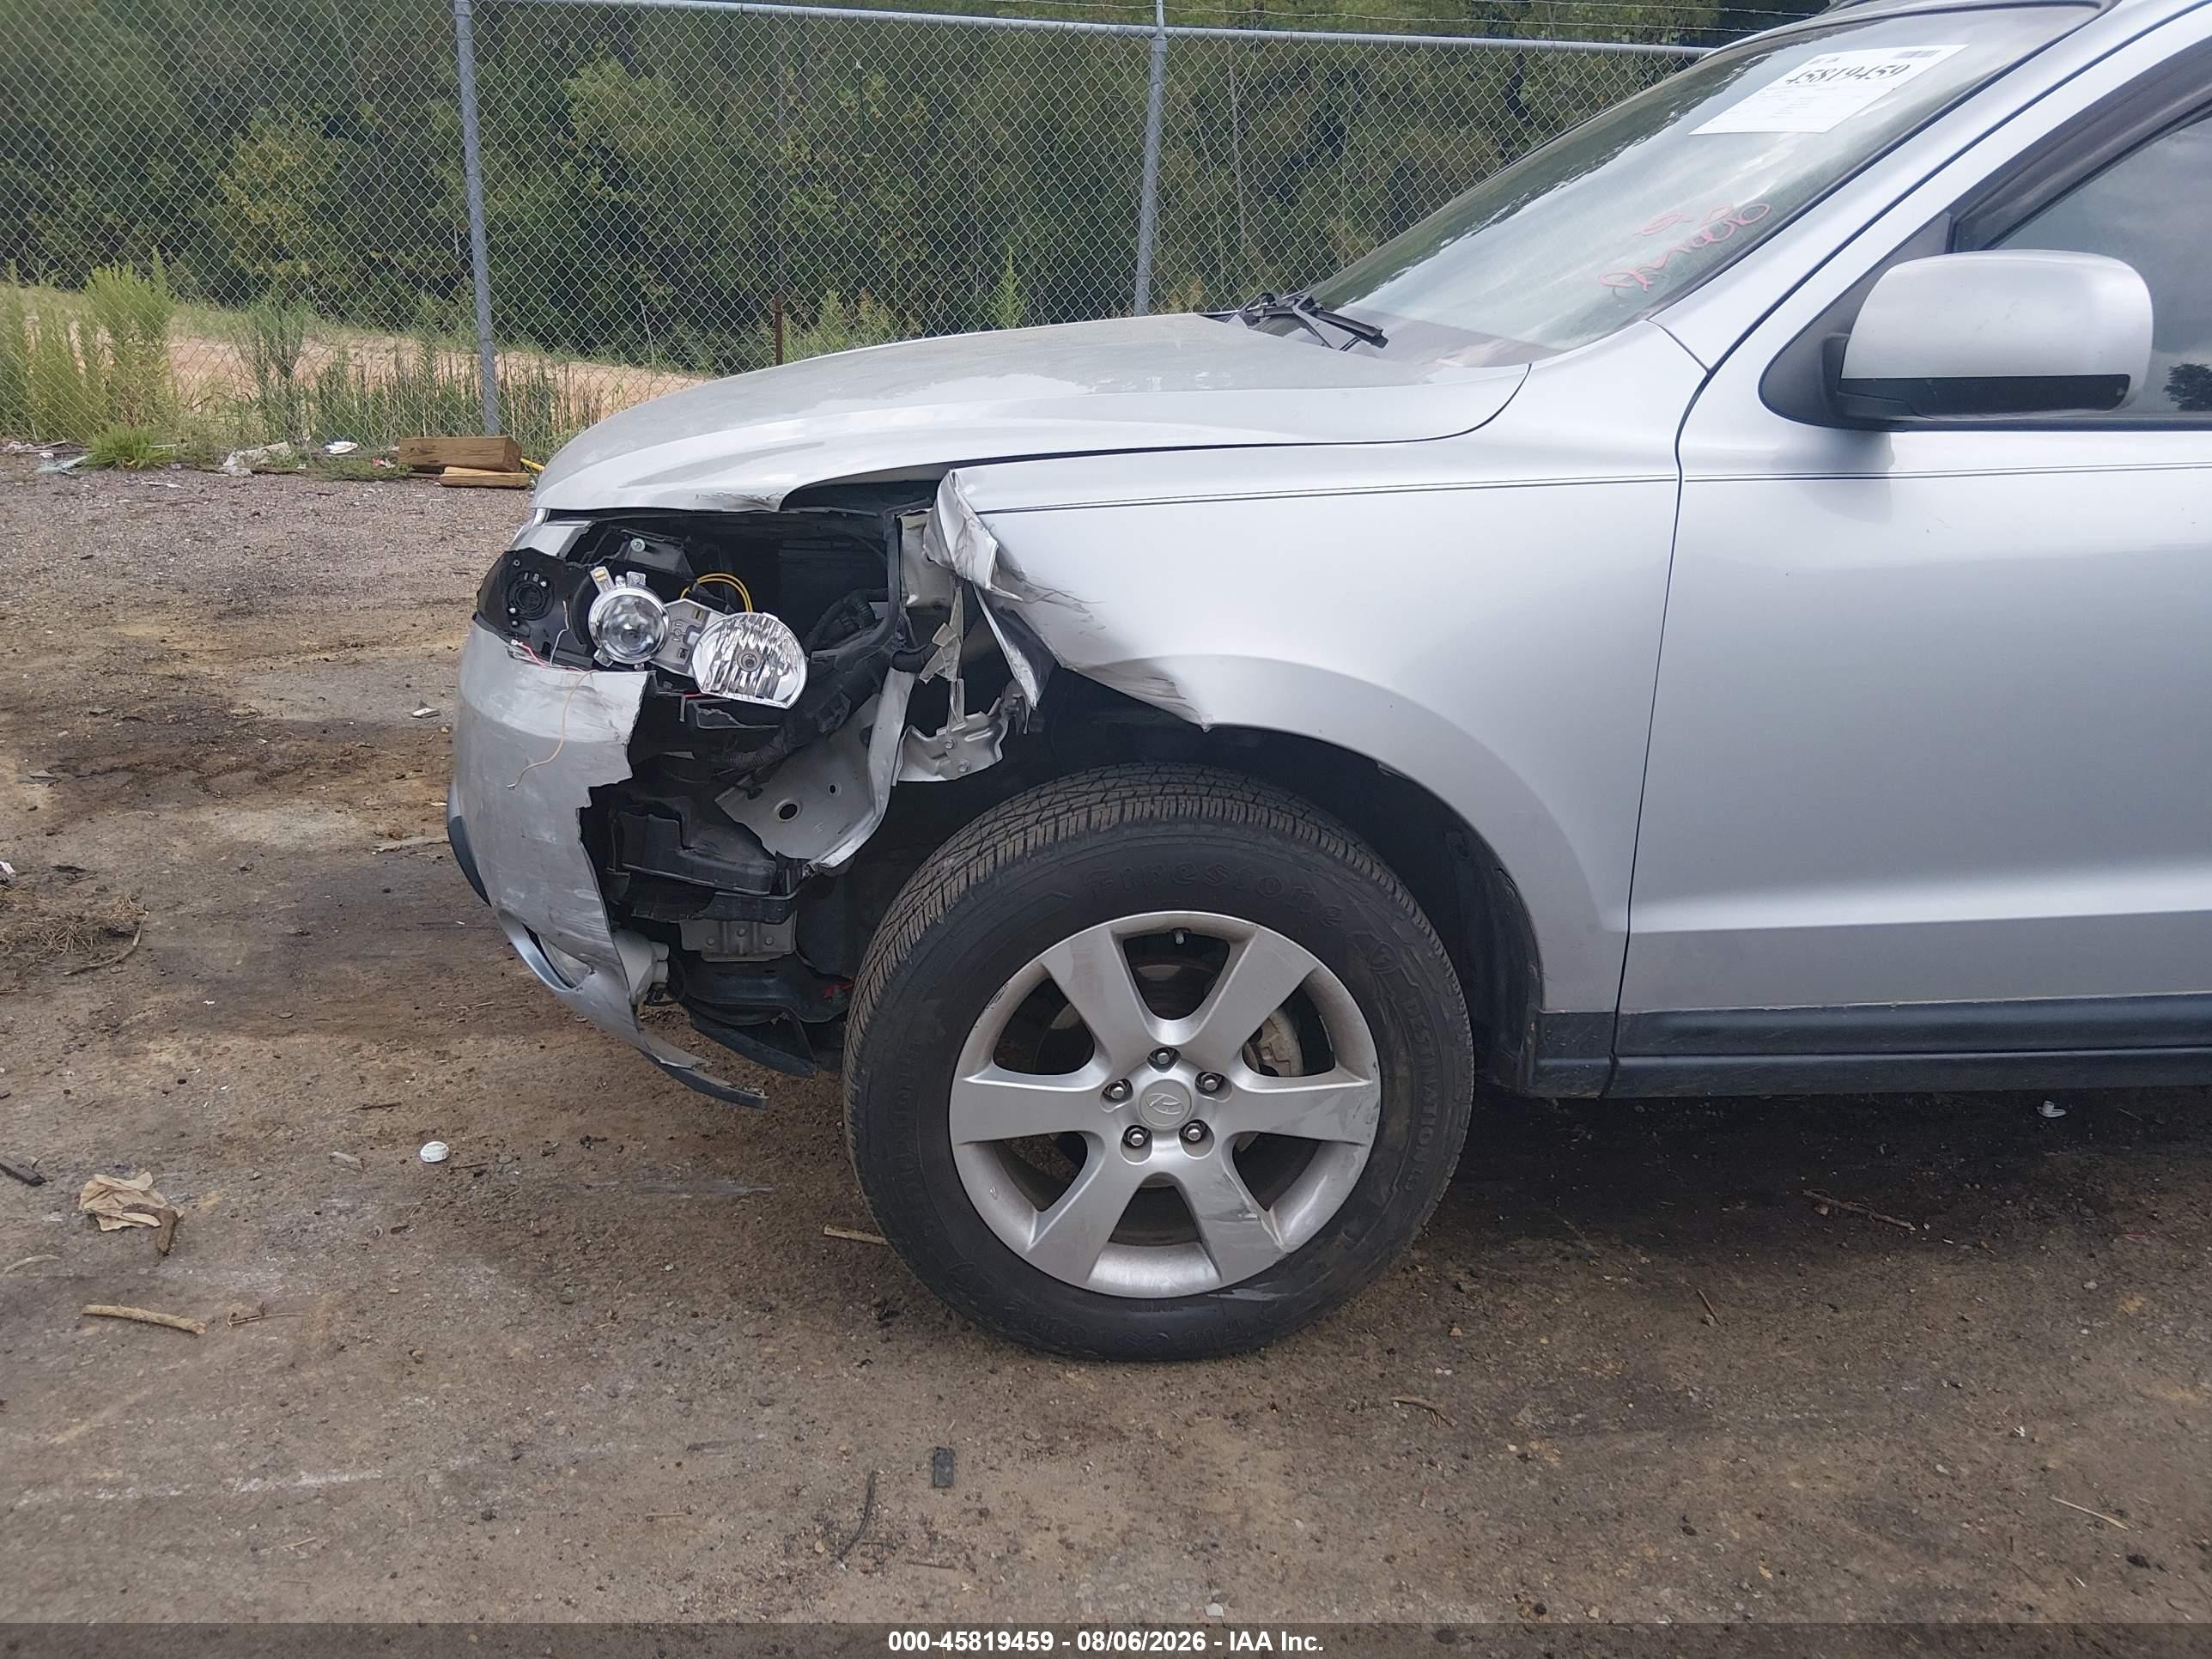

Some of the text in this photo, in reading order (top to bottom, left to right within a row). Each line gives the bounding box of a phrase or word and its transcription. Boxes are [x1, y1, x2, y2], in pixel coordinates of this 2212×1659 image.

[1786, 64, 1911, 85] 45819459
[1085, 860, 1344, 928] Firestone
[1403, 995, 1440, 1162] DESTINATION
